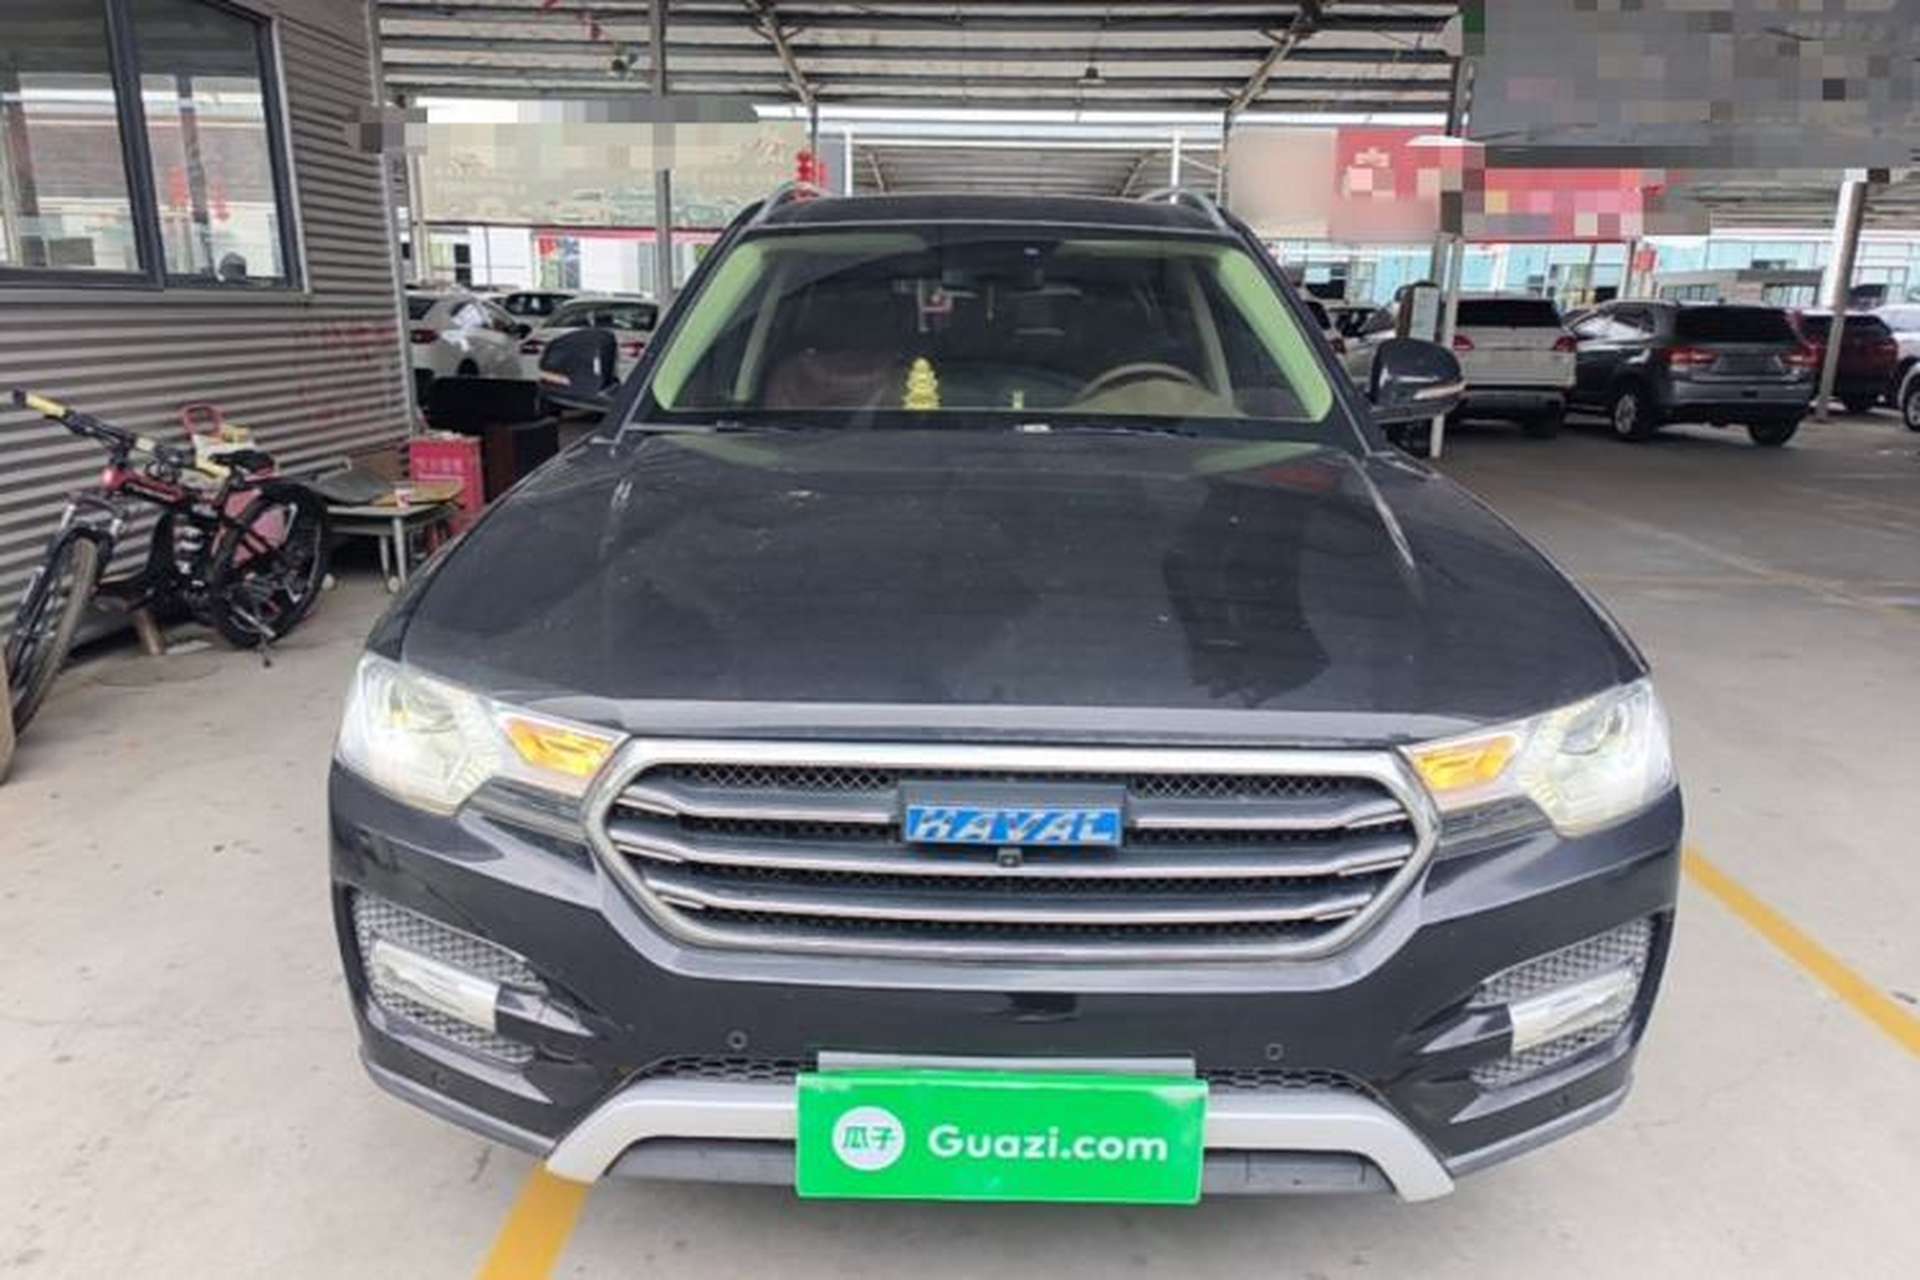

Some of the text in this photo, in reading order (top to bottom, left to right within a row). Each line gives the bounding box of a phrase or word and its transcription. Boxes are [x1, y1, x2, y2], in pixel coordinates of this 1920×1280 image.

[913, 808, 1113, 843] HAVAL
[841, 1124, 897, 1151] 瓜子
[927, 1123, 1168, 1161] Guazi.com
